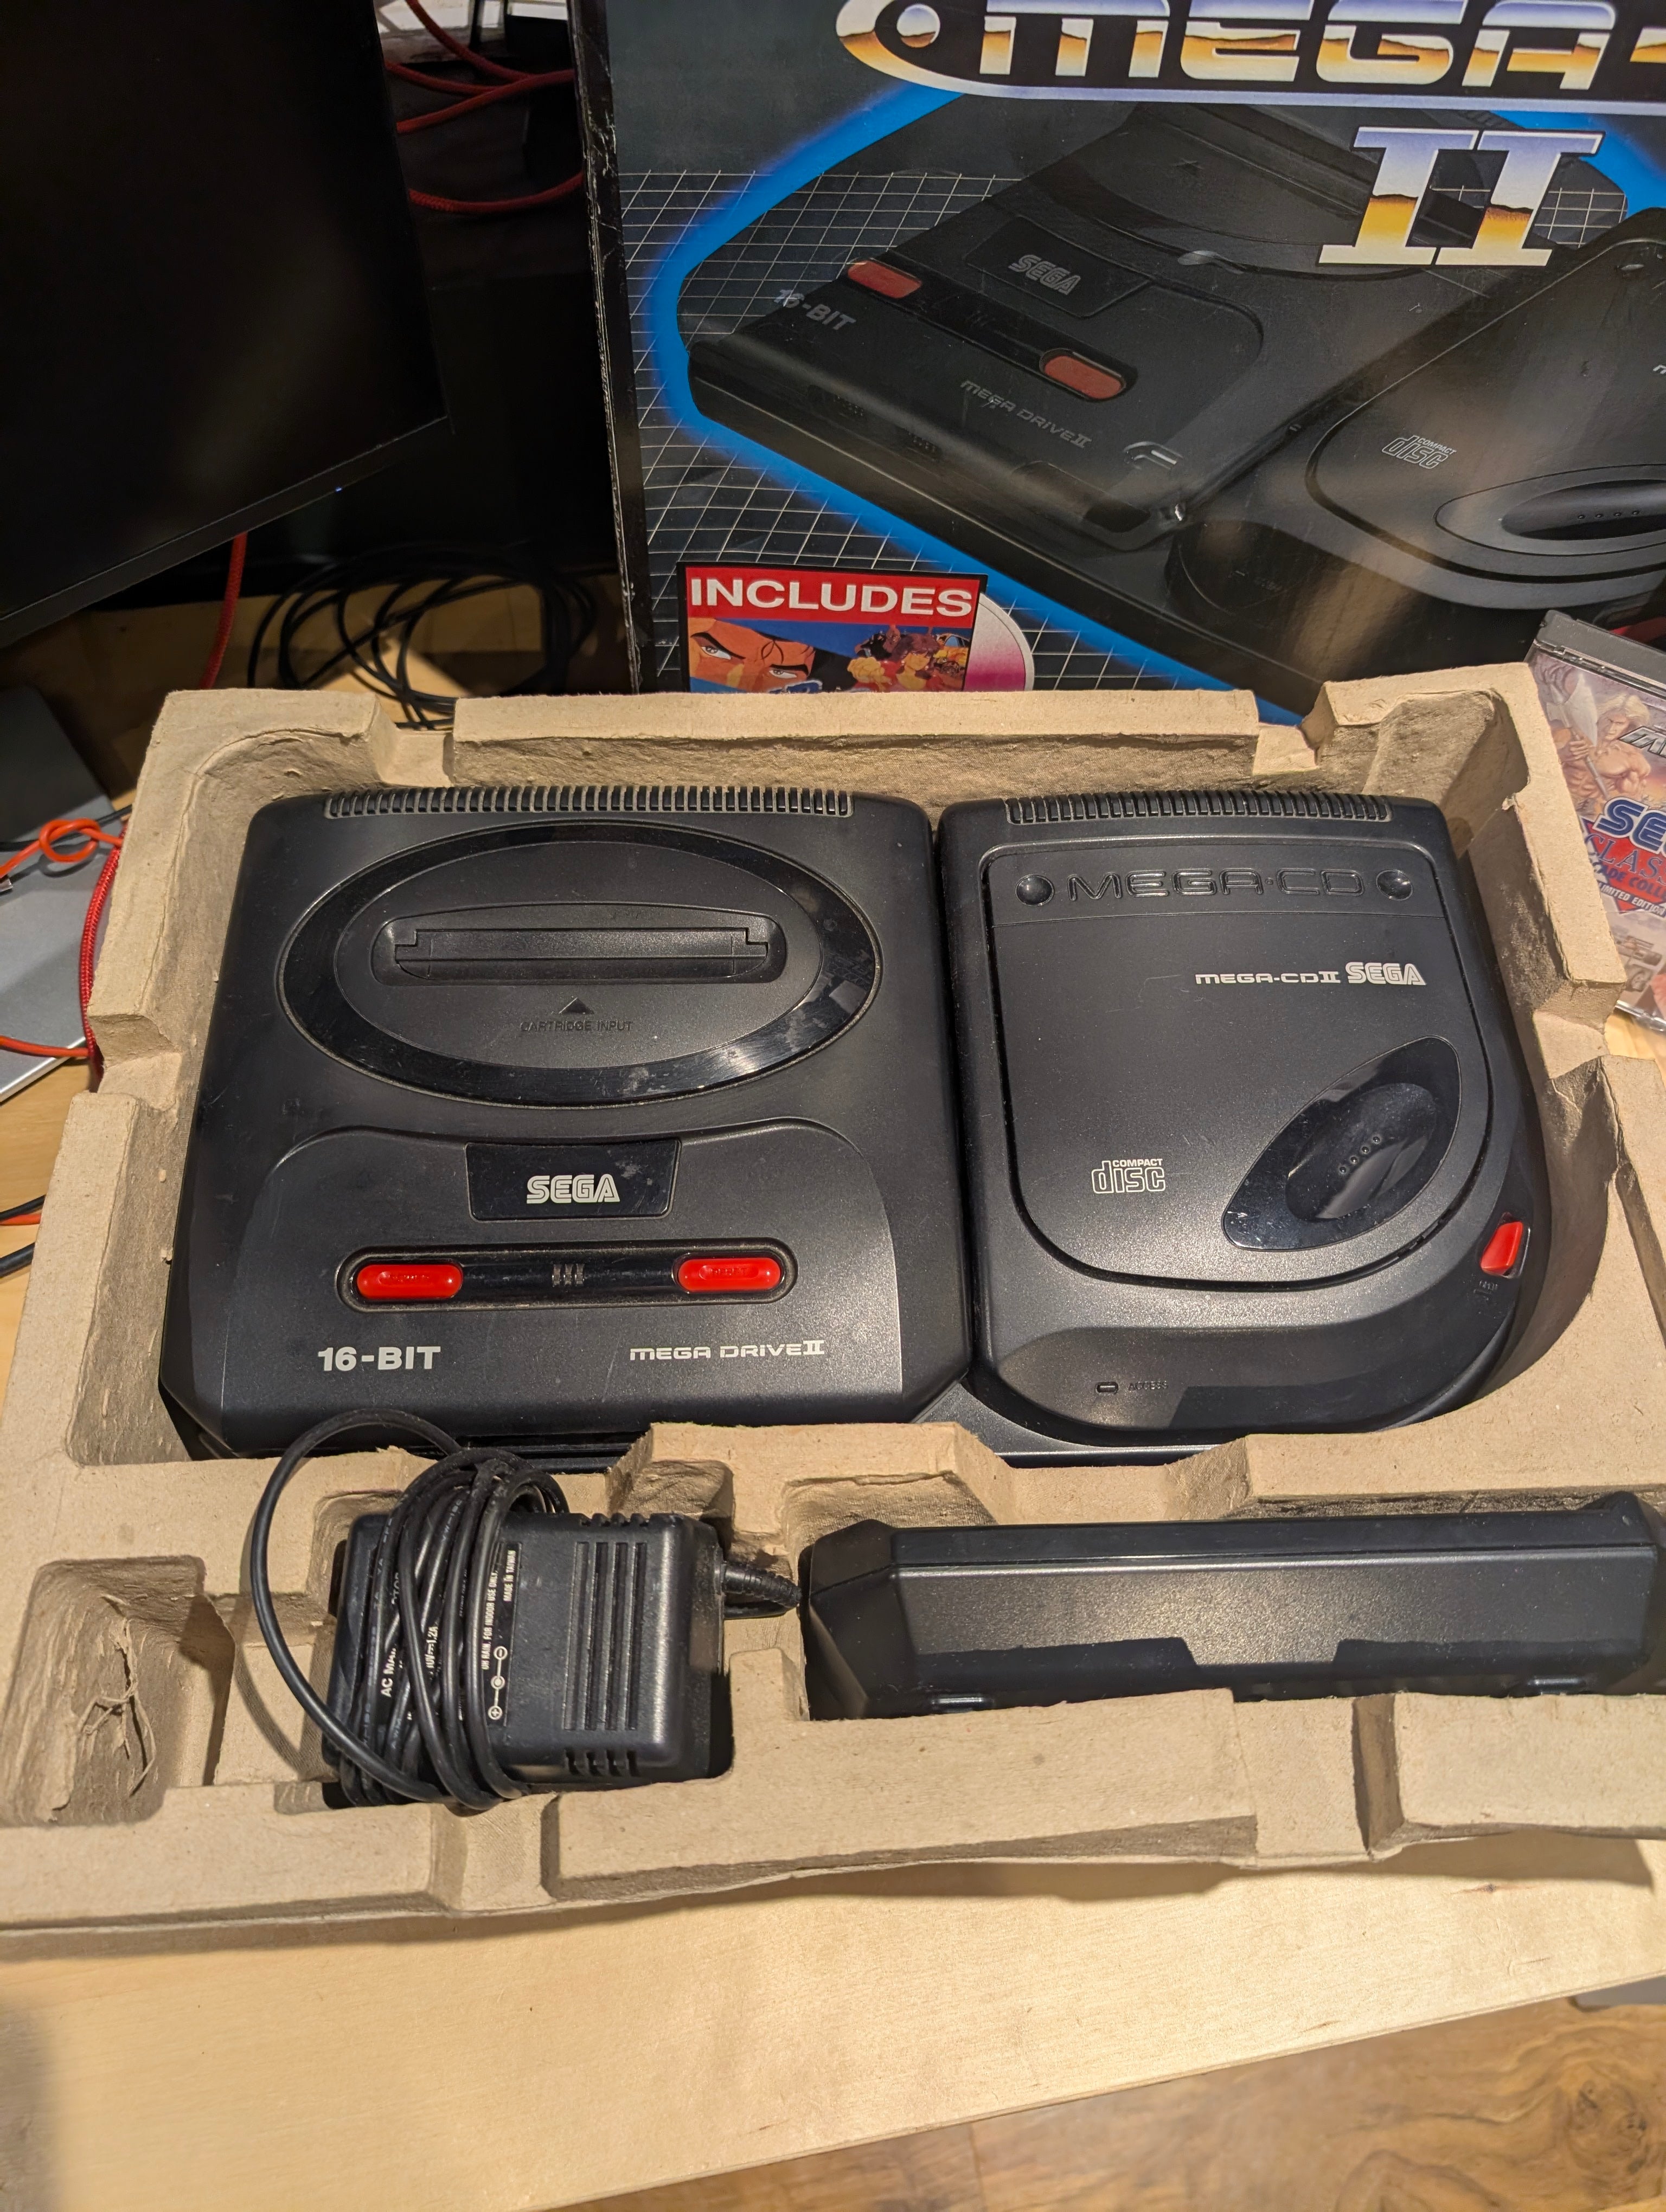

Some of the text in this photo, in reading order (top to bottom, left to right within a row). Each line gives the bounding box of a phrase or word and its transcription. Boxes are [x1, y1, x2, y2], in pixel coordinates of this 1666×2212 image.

[1008, 254, 1083, 295] SEGA
[773, 288, 856, 331] 16-BIT
[960, 380, 1016, 413] MEGA
[1381, 435, 1450, 470] disc
[1417, 438, 1457, 456] COMPACT
[691, 577, 972, 618] INCLUDES
[1593, 797, 1666, 854] SE
[1631, 897, 1665, 916] EDITION
[1345, 962, 1427, 986] SEGA
[520, 1020, 633, 1032] CARTRIDGE INPUT
[1112, 1158, 1163, 1168] COMPACT
[527, 1173, 620, 1204] SEGA
[1092, 1161, 1166, 1194] disc
[318, 1346, 441, 1372] 16-BIT
[630, 1346, 713, 1361] MEGA
[506, 1549, 517, 1573] TAIWAN
[487, 1589, 497, 1602] USE
[502, 1583, 514, 1602] MADE
[484, 1602, 496, 1626] INDOOR
[482, 1626, 493, 1640] FOR
[380, 1678, 393, 1697] AC
